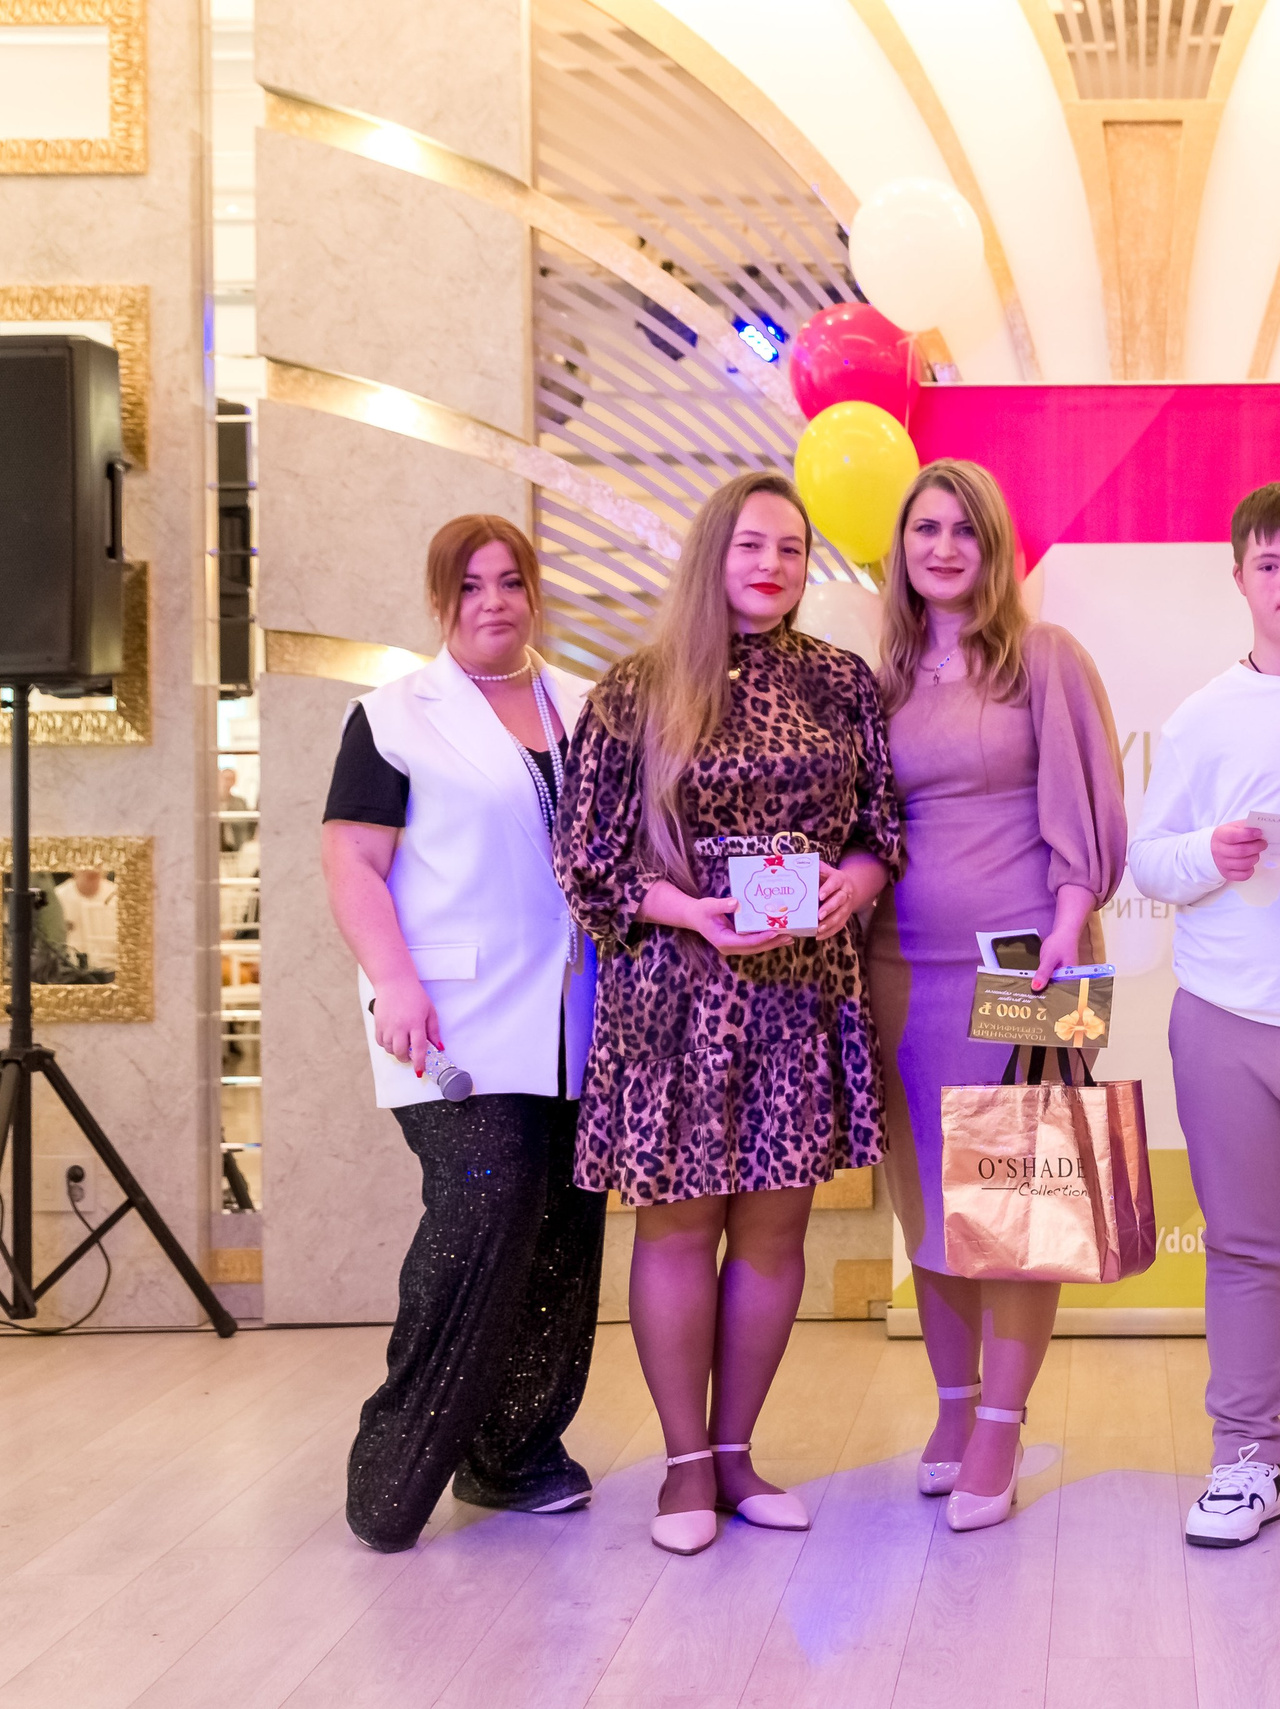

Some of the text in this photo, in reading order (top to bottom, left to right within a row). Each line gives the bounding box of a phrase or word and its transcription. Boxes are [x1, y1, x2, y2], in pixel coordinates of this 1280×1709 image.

[754, 883, 795, 899] Адель
[973, 1028, 1046, 1041] ПОДАРОЧНЫЙ
[978, 1022, 1043, 1034] СЕРТИФИКАТ
[1018, 1181, 1088, 1197] Collection
